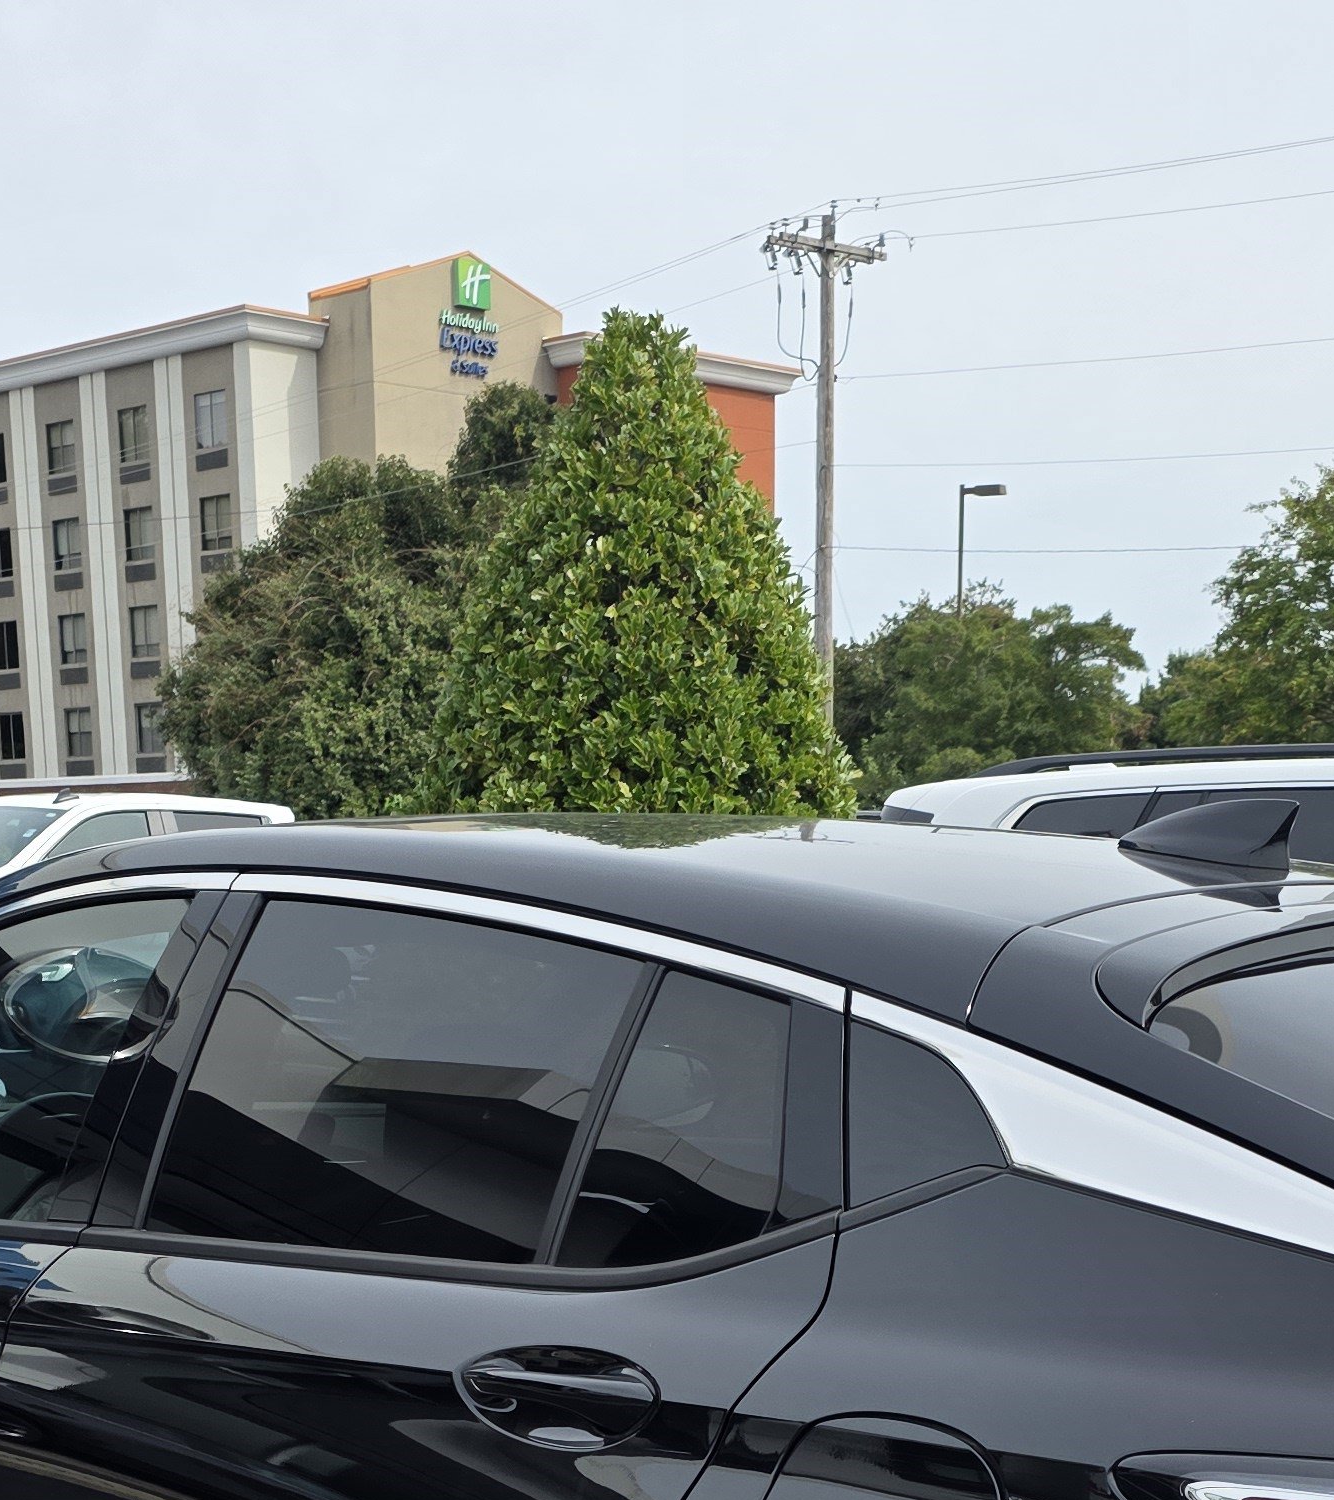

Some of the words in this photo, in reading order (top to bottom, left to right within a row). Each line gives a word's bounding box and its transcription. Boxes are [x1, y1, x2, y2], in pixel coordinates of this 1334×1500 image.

[441, 308, 483, 334] Holiday
[482, 315, 500, 333] Inn
[441, 327, 499, 357] Express
